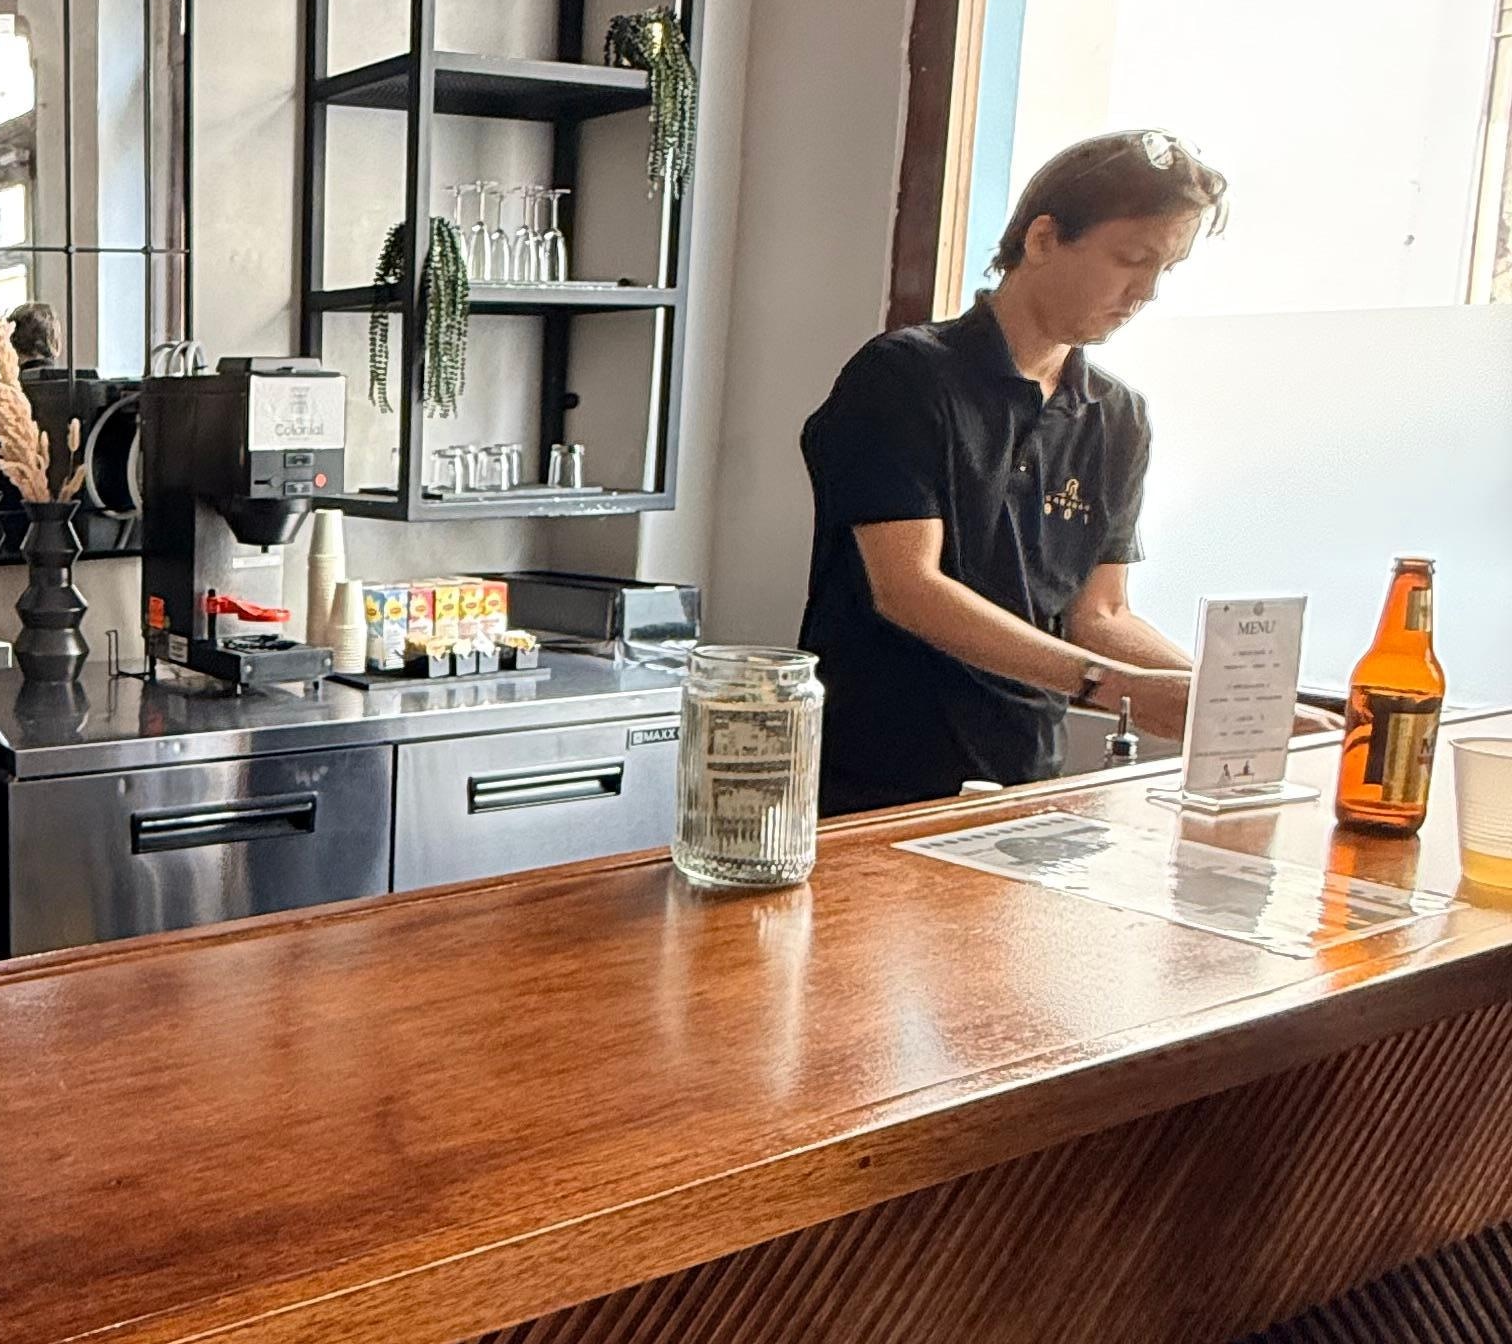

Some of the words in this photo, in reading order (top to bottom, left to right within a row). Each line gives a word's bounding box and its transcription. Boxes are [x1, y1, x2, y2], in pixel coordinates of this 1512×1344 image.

[274, 422, 325, 437] Colonial
[1238, 620, 1277, 635] MENU
[643, 727, 676, 743] MAXX
